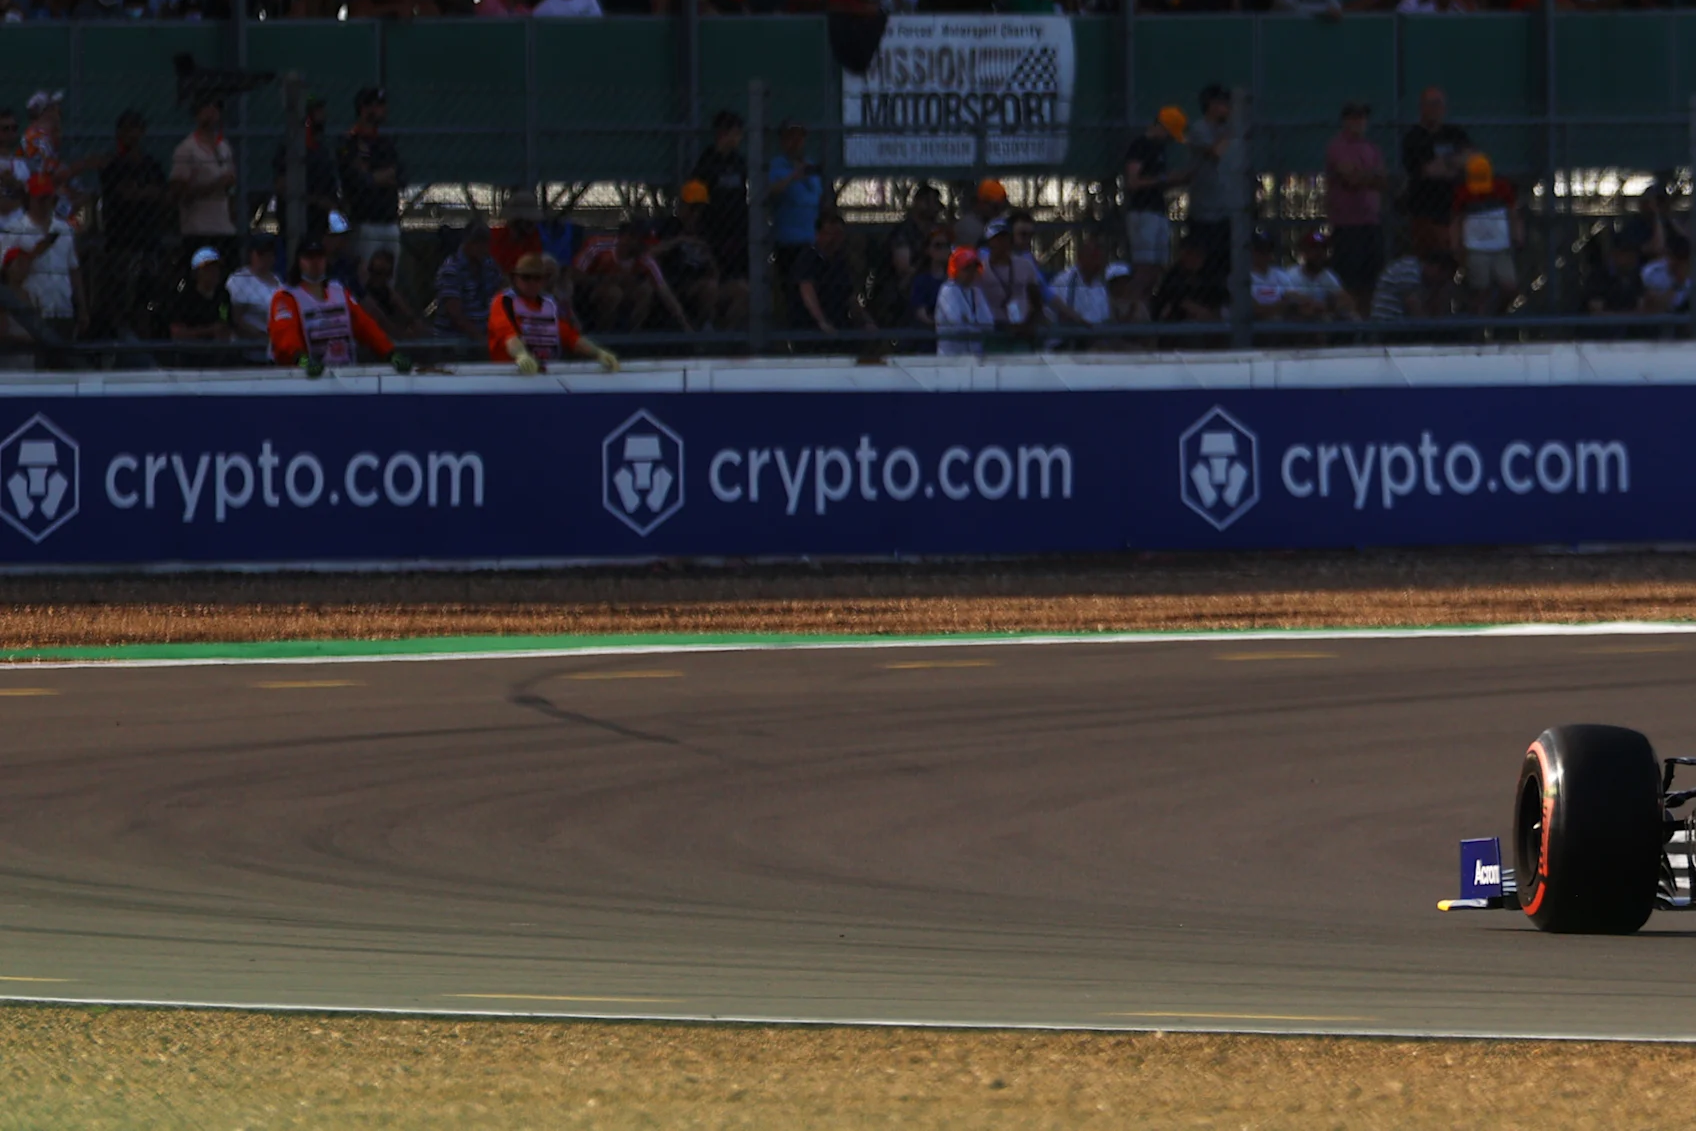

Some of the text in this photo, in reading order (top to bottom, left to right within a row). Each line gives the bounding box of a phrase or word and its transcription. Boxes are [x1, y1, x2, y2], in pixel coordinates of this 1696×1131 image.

[861, 92, 1058, 133] MOTORSPORT
[106, 440, 484, 523] crypto.com
[709, 436, 1073, 515] crypto.com
[1281, 431, 1629, 510] crypto.com
